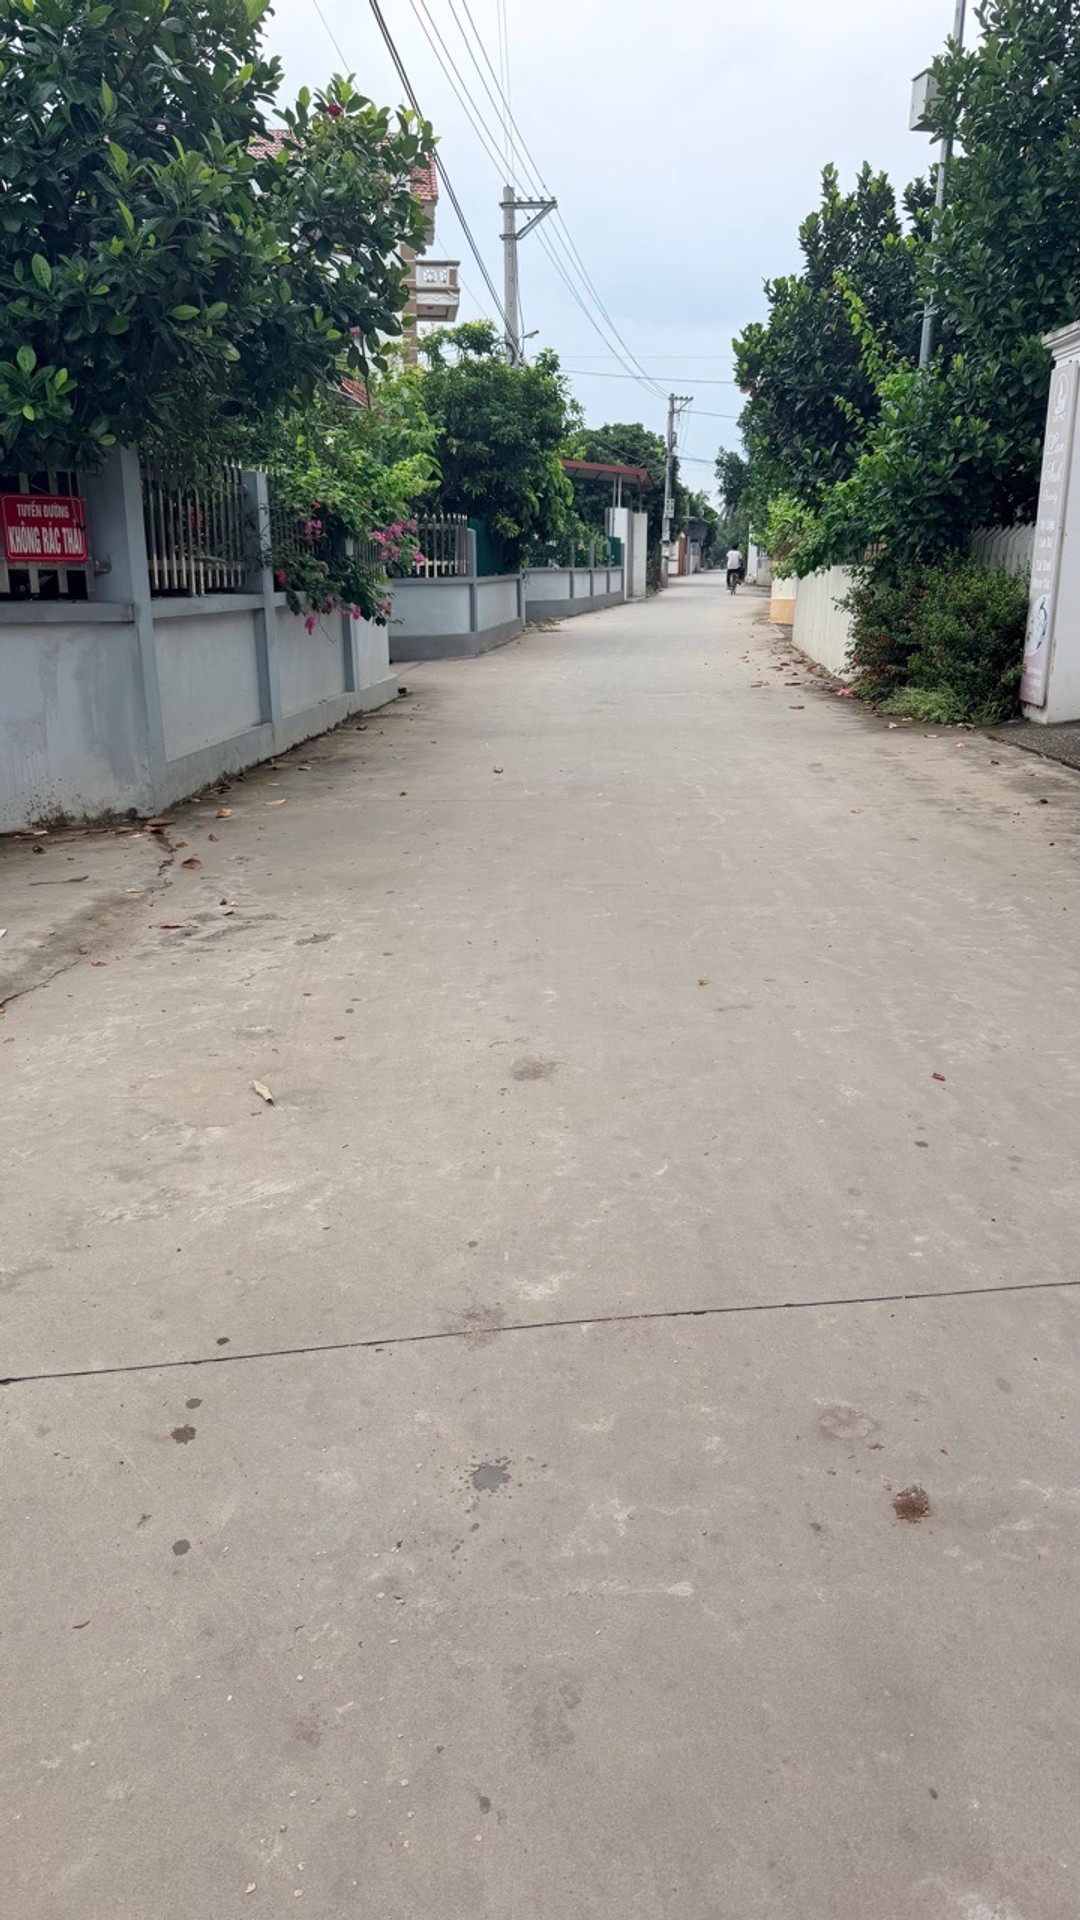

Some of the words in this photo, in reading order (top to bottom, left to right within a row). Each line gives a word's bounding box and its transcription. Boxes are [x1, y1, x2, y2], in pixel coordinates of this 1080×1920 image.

[16, 500, 42, 517] TUYẾN
[43, 502, 70, 518] ĐƯỜNG
[8, 520, 42, 554] KHÔNG
[41, 521, 62, 554] RÁC
[61, 519, 84, 555] THẢI
